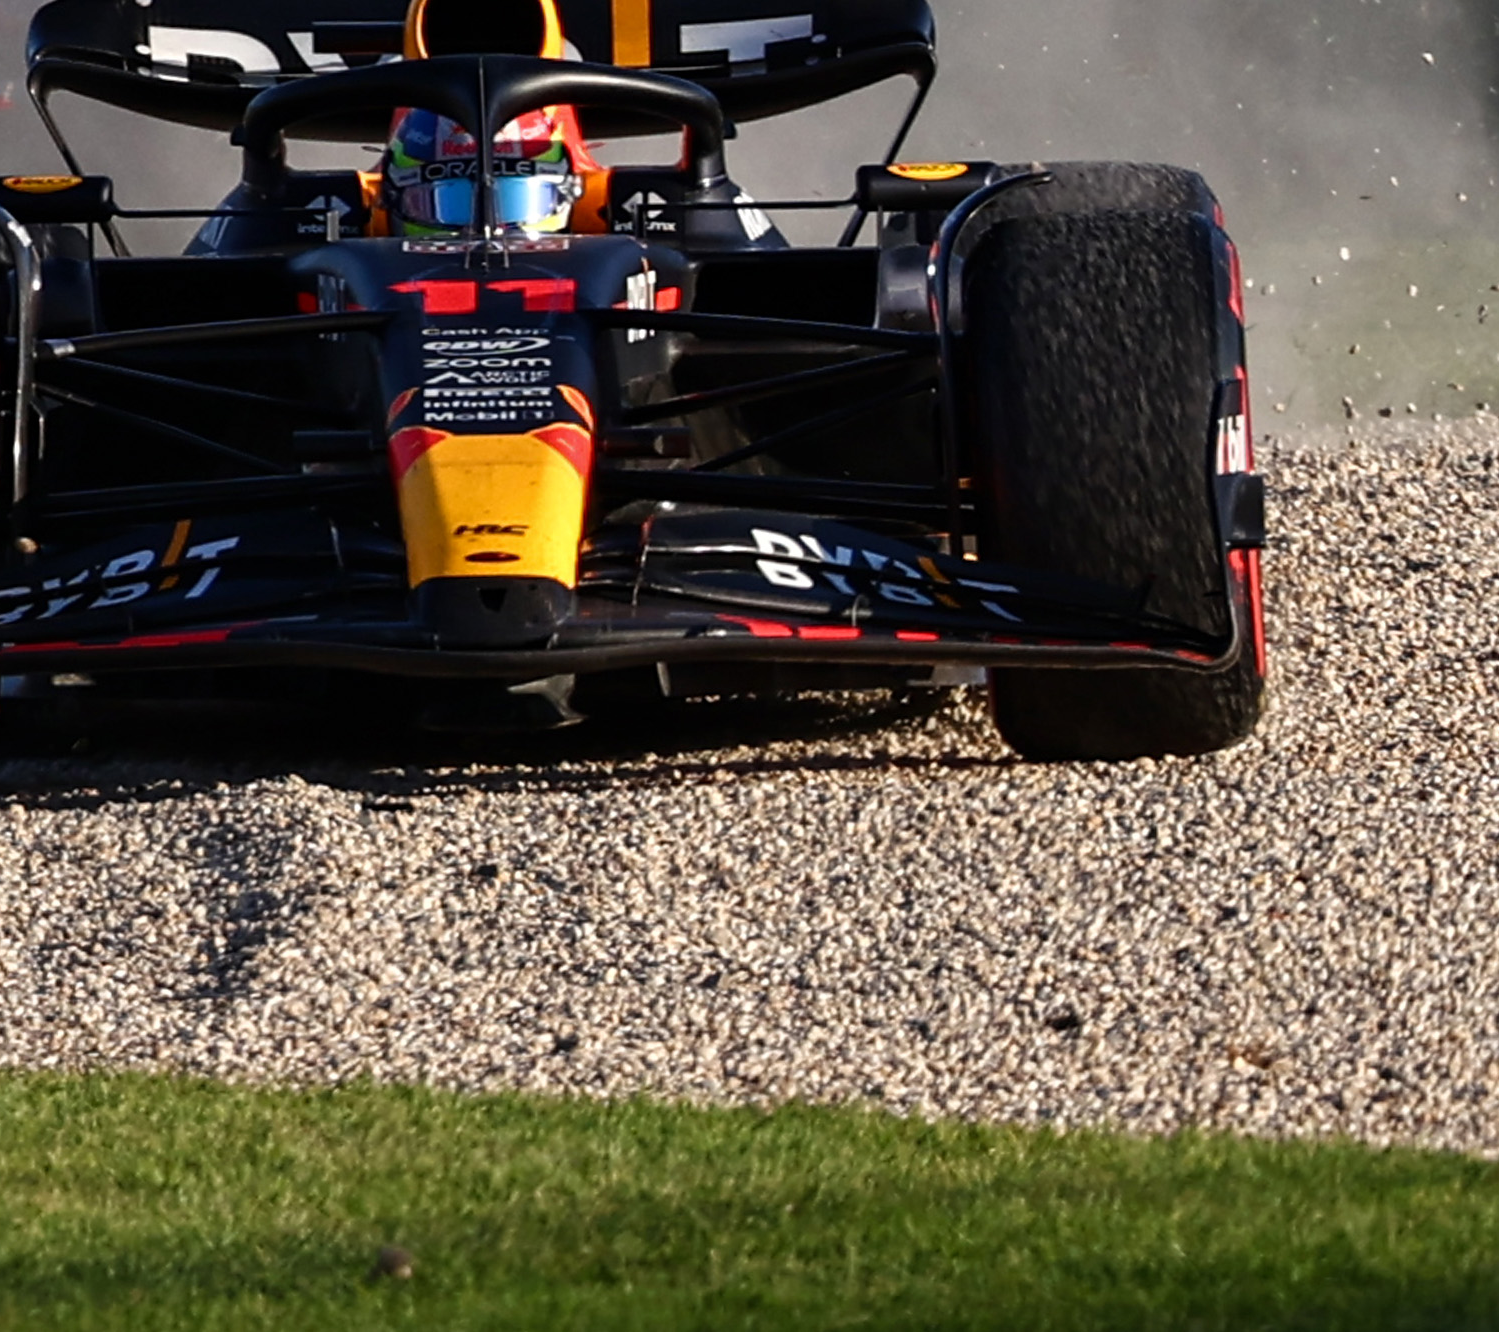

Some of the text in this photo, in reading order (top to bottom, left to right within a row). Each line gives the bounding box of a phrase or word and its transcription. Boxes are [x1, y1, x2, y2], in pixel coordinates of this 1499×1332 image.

[387, 278, 578, 315] 11
[421, 327, 489, 336] Cash
[423, 357, 552, 368] zoom
[424, 411, 518, 422] Mobil
